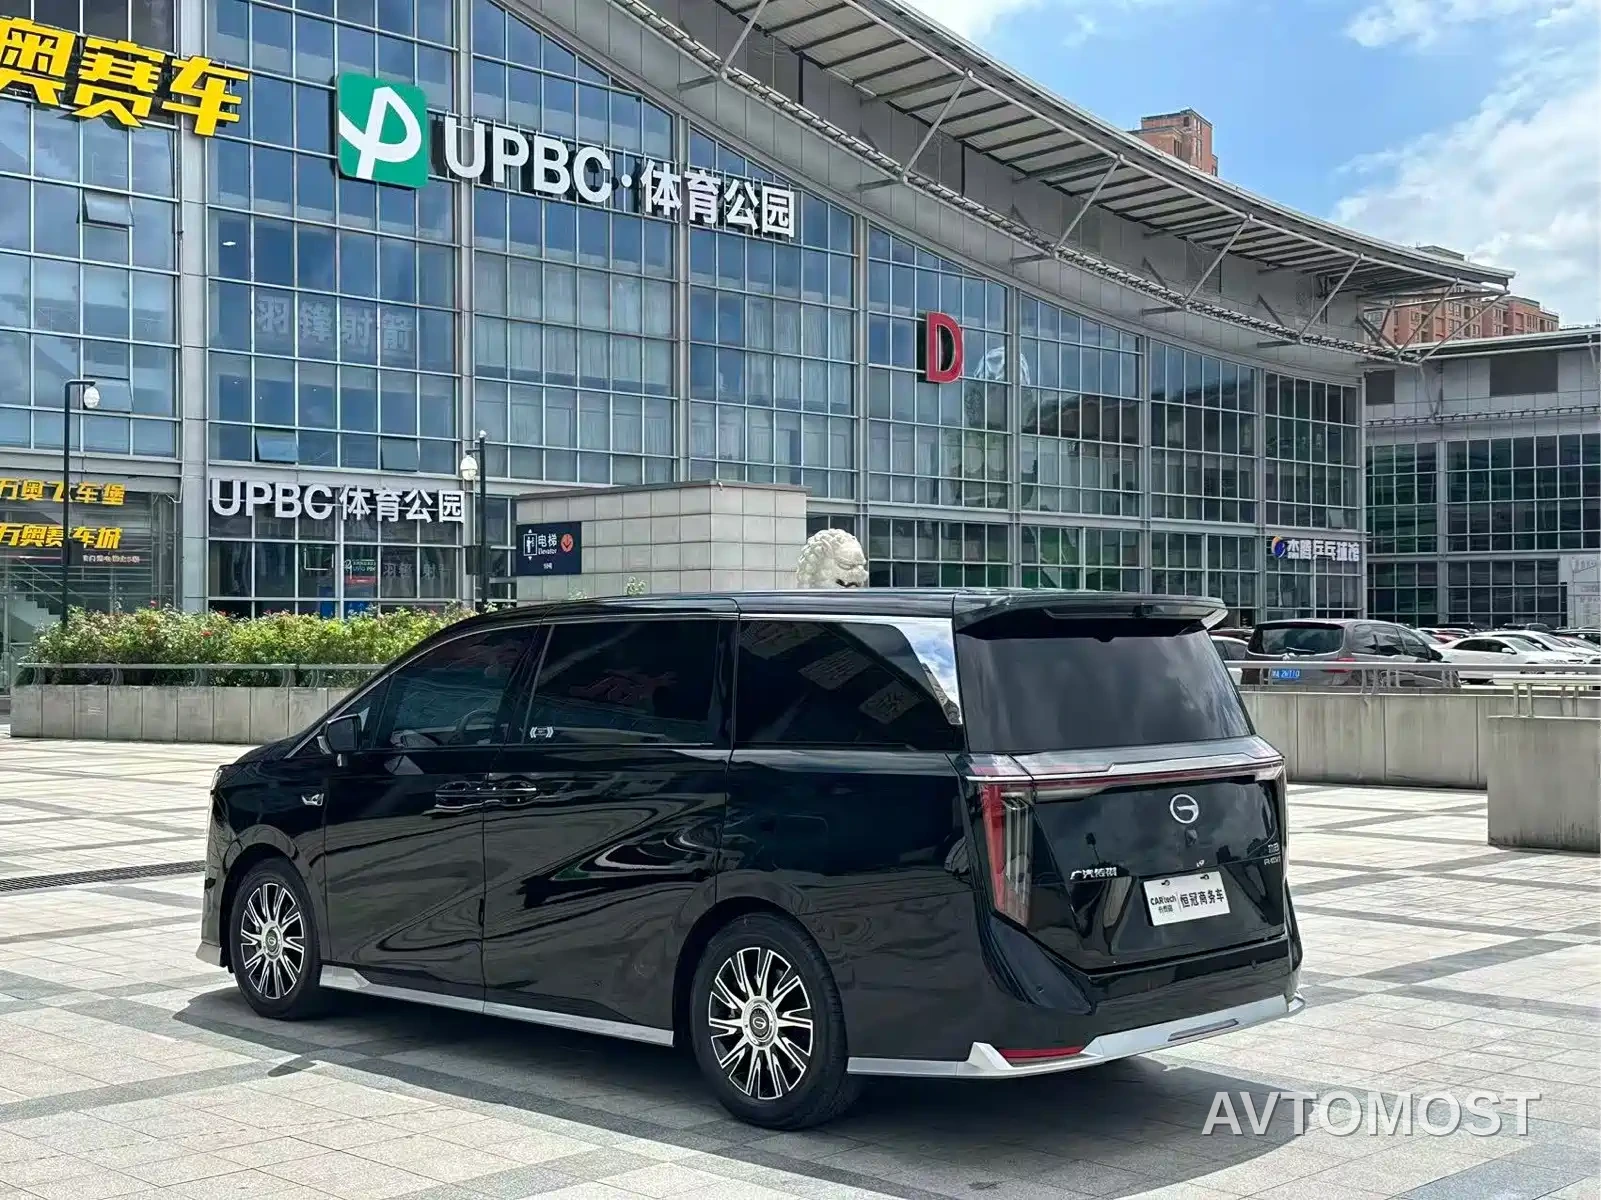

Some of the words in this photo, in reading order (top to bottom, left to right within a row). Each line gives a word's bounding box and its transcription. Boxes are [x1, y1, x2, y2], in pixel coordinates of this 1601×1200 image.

[926, 311, 964, 383] D
[538, 533, 557, 547] 电梯
[1180, 888, 1224, 908] 恒冠商务车
